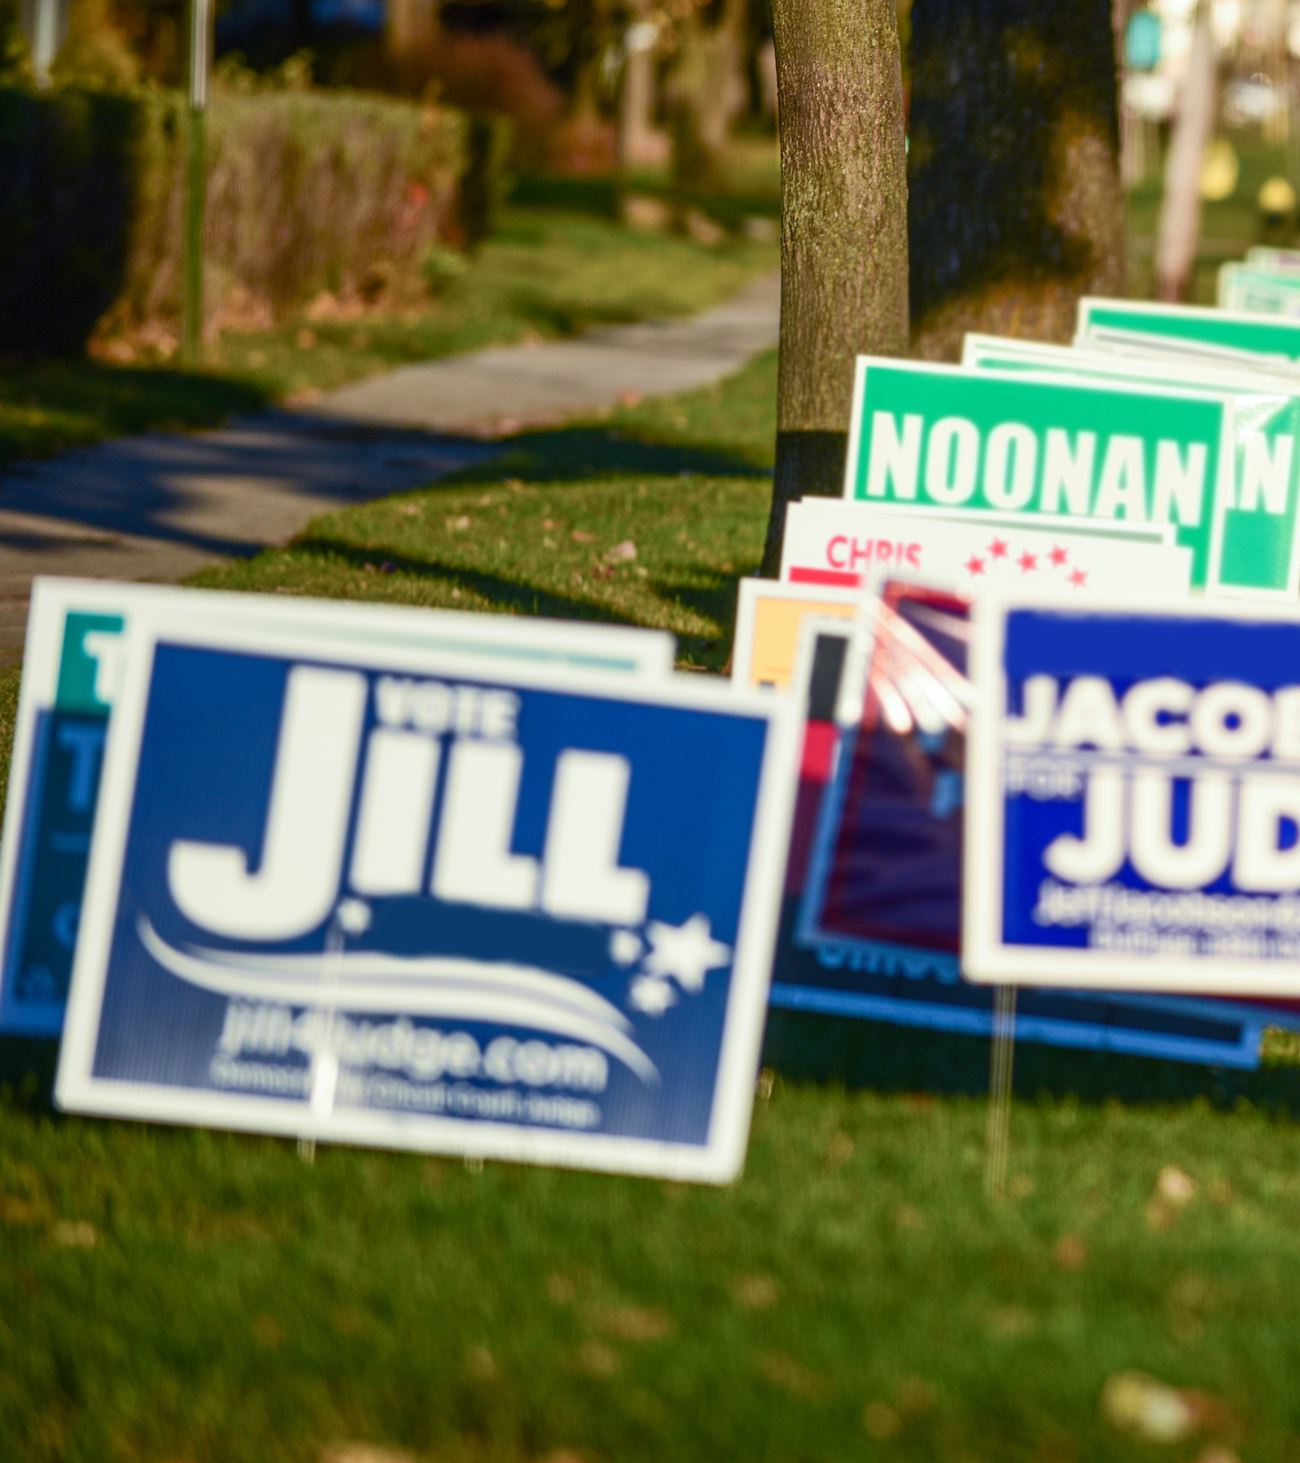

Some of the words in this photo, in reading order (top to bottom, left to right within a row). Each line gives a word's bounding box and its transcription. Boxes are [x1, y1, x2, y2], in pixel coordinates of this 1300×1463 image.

[866, 410, 1208, 528] NOONAN
[826, 535, 922, 570] CHRIS
[374, 673, 521, 742] VOTE
[167, 665, 651, 942] JILL
